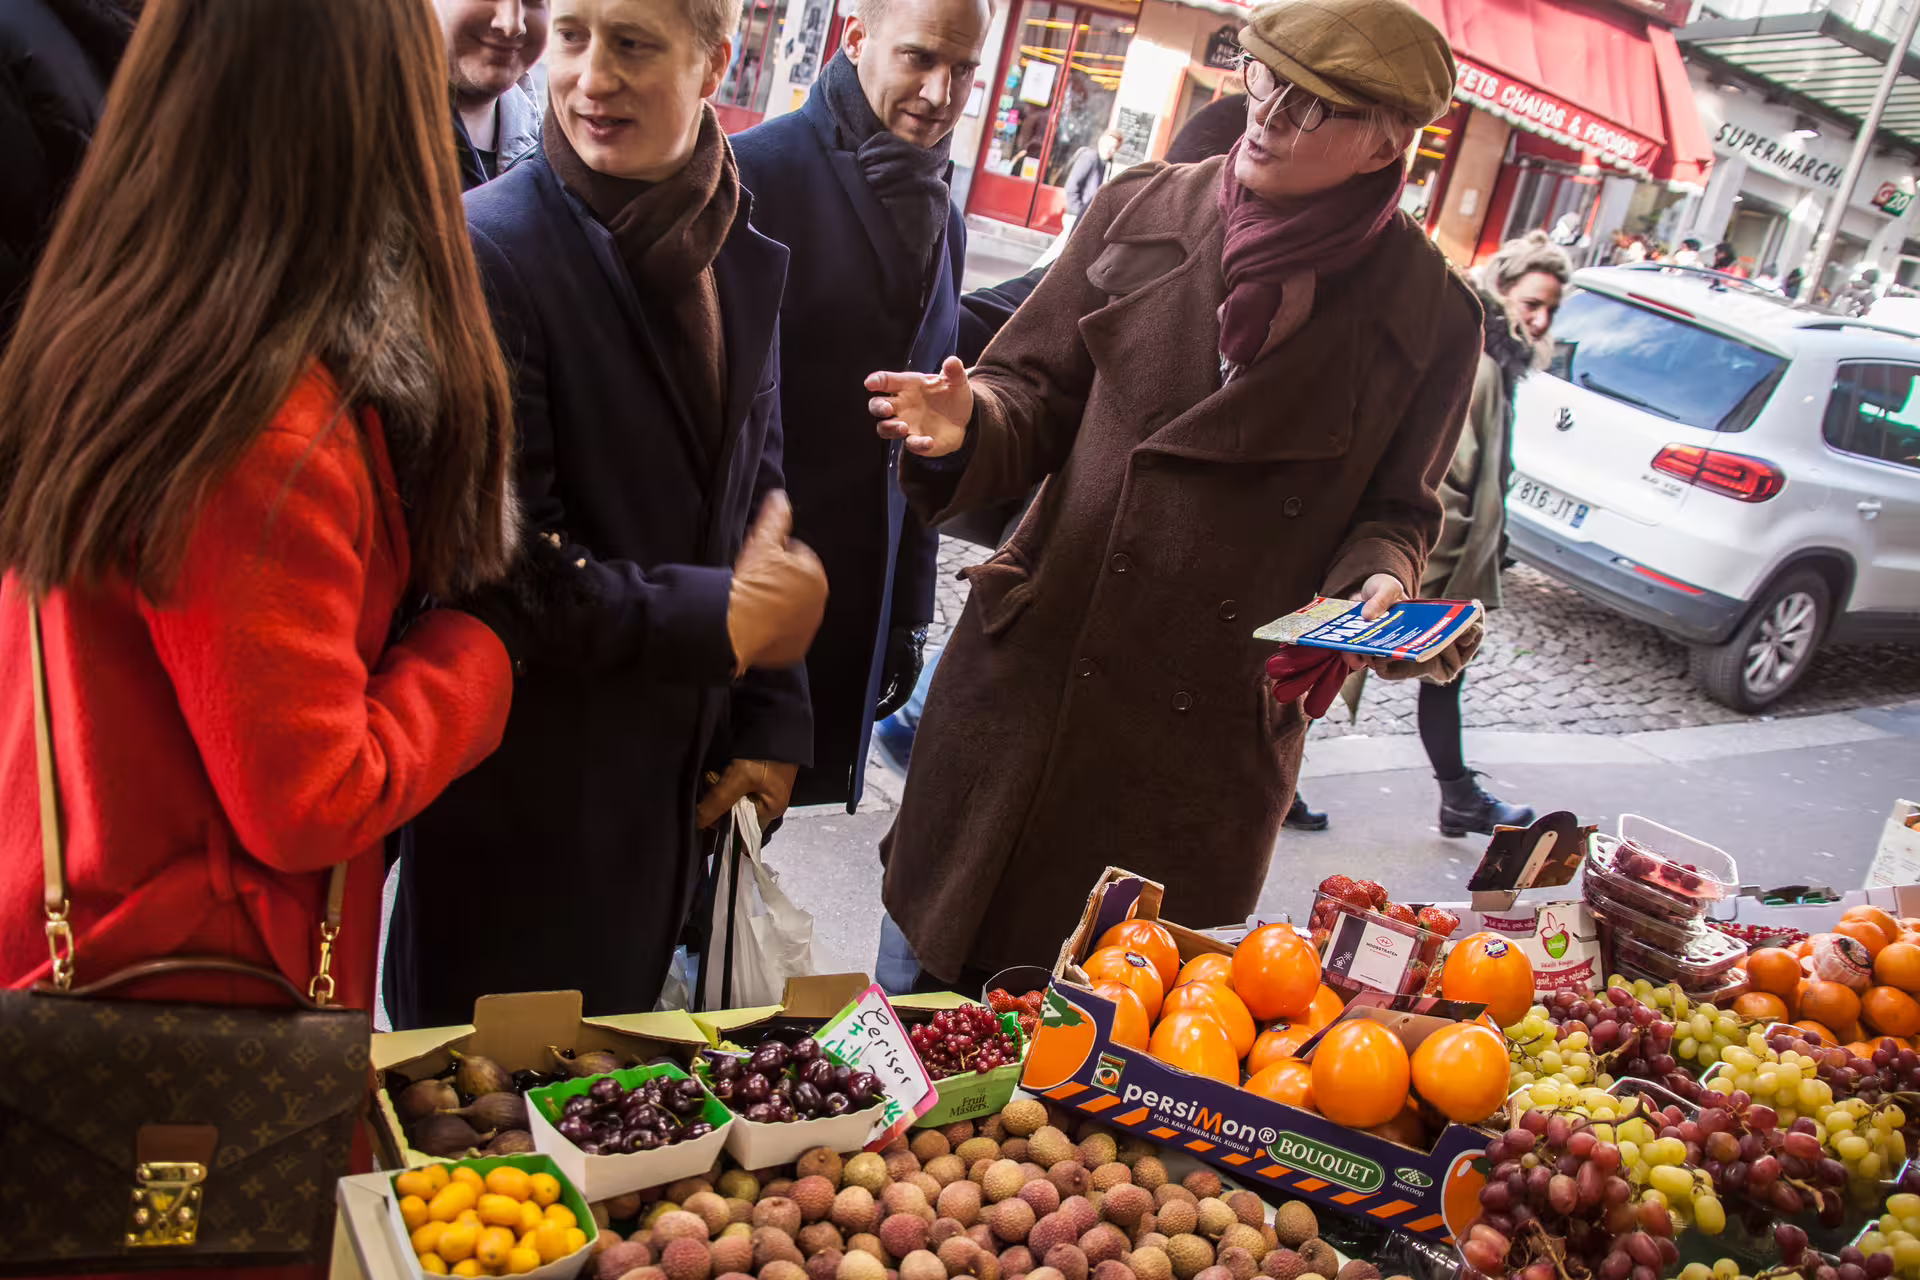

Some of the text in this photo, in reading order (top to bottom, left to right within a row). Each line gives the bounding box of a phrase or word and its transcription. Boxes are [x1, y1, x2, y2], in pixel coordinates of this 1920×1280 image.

[1501, 85, 1567, 128] CHAUDS
[1568, 115, 1581, 136] &
[1584, 122, 1639, 159] FROIDS
[1714, 123, 1844, 189] SUPERMARCH
[962, 1094, 987, 1107] Fruit
[1171, 1120, 1187, 1131] KAKI
[1187, 1125, 1210, 1139] RIBERA
[1210, 1134, 1223, 1145] DEL
[1278, 1137, 1374, 1184] BOUQUET
[1392, 1180, 1425, 1198] Anecoop
